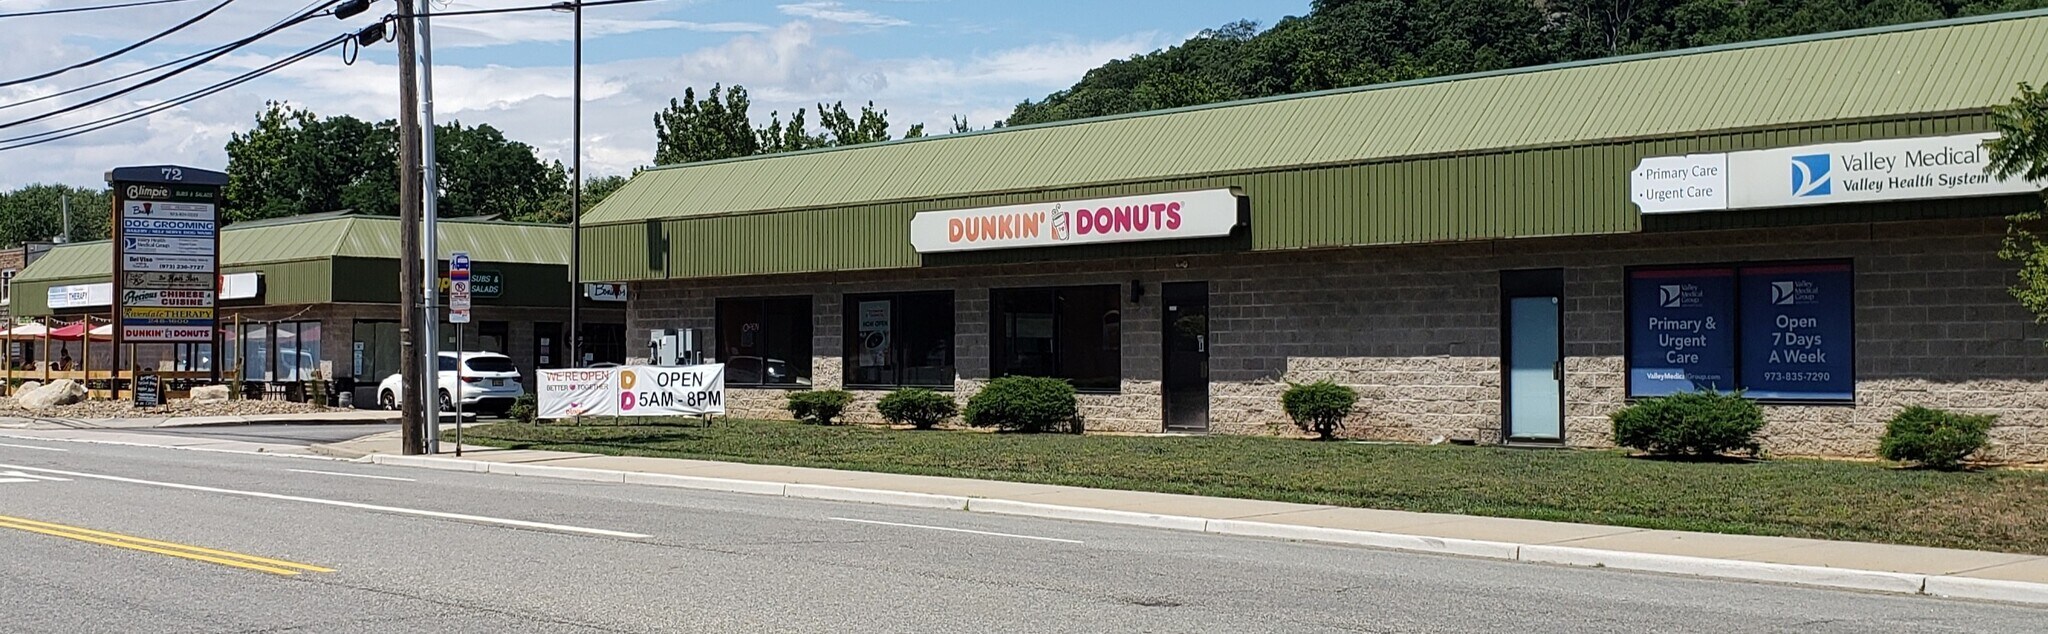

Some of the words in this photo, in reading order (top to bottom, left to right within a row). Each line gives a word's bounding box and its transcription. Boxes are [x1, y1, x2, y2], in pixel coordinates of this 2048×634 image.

[1841, 151, 1896, 173] Valley
[1905, 144, 1982, 168] Medical
[161, 168, 182, 181] 72
[1646, 167, 1688, 181] Primary
[1691, 165, 1718, 177] Care
[1843, 178, 1883, 193] Valley
[1888, 172, 1933, 189] Health
[1938, 171, 1989, 188] System
[127, 185, 168, 199] Blimpie
[1646, 185, 1683, 202] Urgent
[1686, 185, 1713, 198] Care
[124, 219, 150, 228] DOG
[153, 220, 214, 230] GROOMING
[949, 211, 1046, 243] DUNKIN'
[1076, 201, 1182, 235] DONUTS
[471, 274, 491, 283] SUBS
[493, 275, 499, 283] &
[1795, 280, 1813, 288] Valley
[159, 290, 205, 299] CHINESE
[471, 285, 499, 293] SALADS
[1681, 284, 1698, 292] Valley
[1681, 289, 1703, 297] Medical
[1795, 286, 1819, 294] Medical
[161, 298, 203, 306] CUISINE
[163, 310, 212, 319] THERAPY
[1649, 317, 1702, 333] Primary
[1705, 316, 1717, 330] &
[1775, 315, 1817, 330] Open
[126, 329, 164, 337] DUNKIN'
[173, 329, 209, 338] DONUTS
[1658, 334, 1707, 349] Urgent
[1771, 332, 1781, 346] 7
[1786, 332, 1822, 349] Days
[1666, 351, 1699, 364] Care
[1768, 350, 1781, 363] A
[1783, 348, 1826, 363] Week
[547, 371, 578, 382] WE'RE
[580, 370, 609, 381] OPEN
[657, 371, 703, 388] OPEN
[1646, 372, 1721, 381] ValleyMedicalGroup.com
[639, 391, 674, 407] 5AM
[687, 390, 722, 406] 8PM
